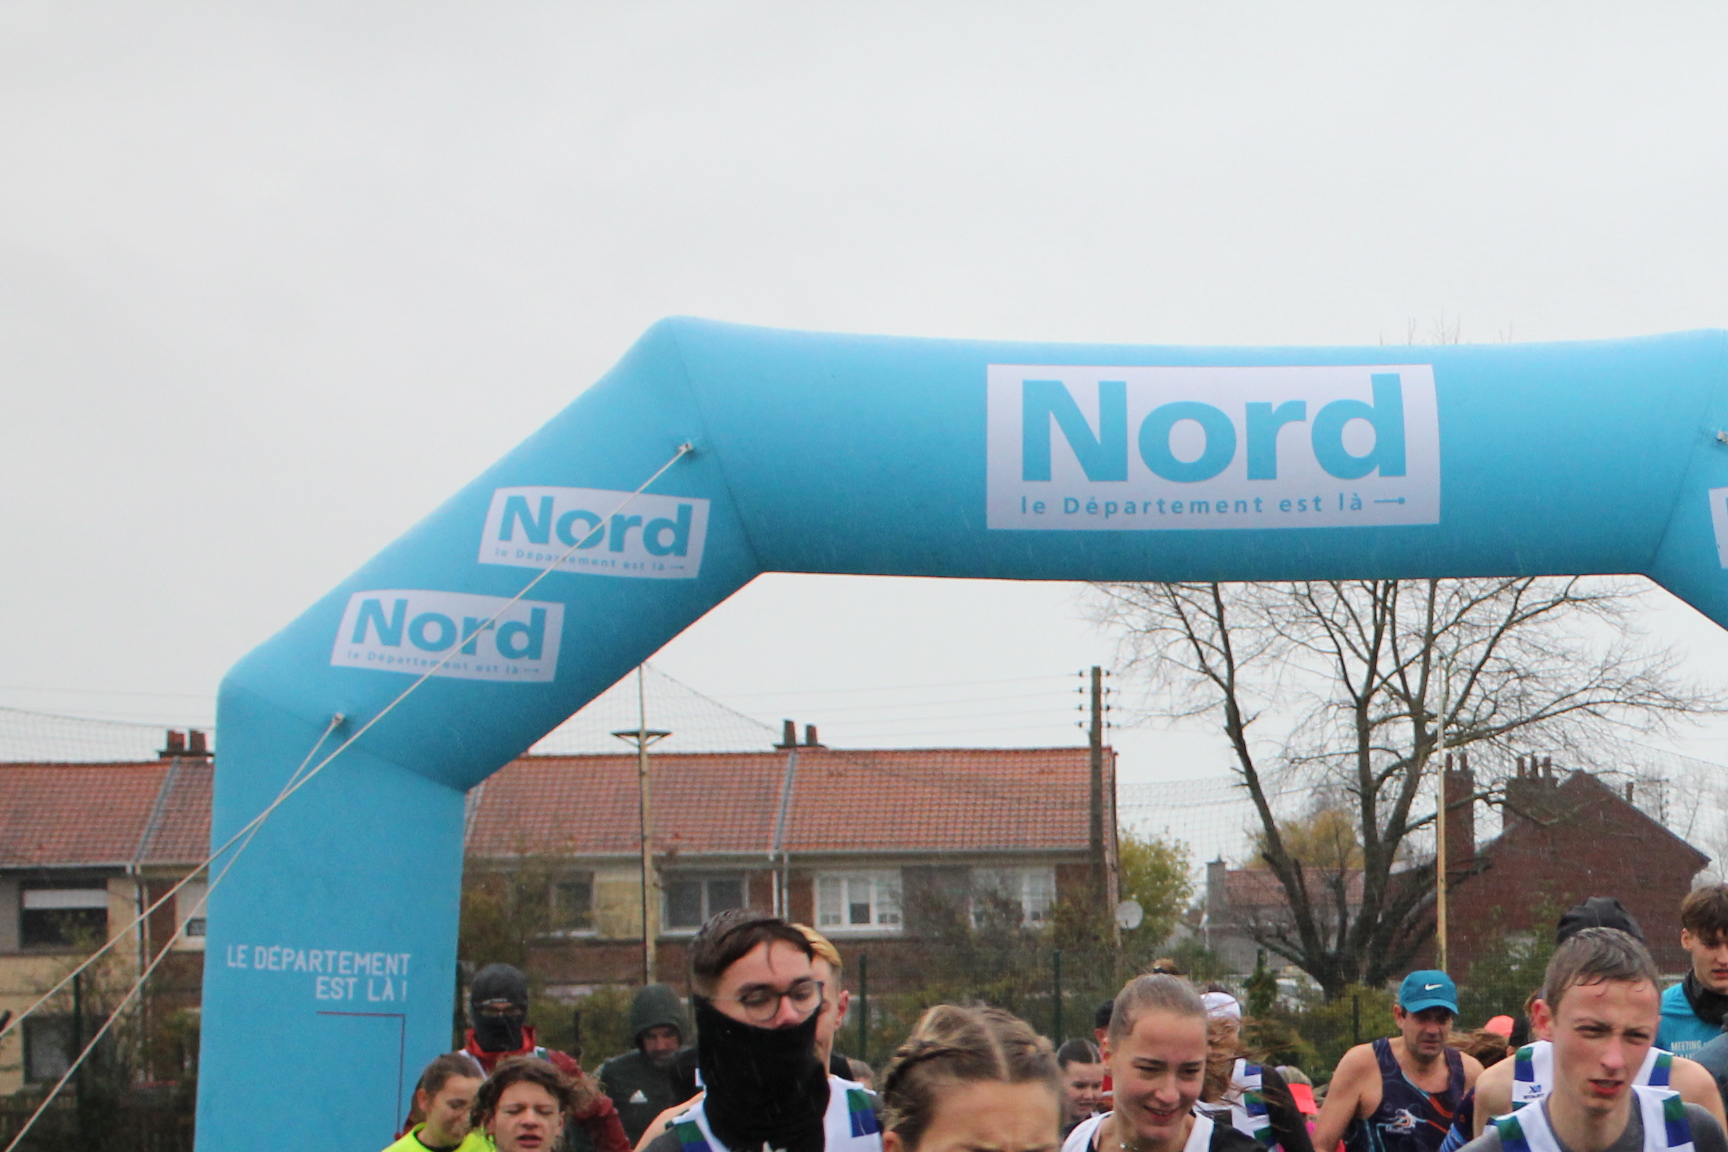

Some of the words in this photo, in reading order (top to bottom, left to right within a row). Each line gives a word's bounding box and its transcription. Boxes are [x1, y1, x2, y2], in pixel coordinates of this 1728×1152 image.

[1022, 373, 1406, 483] Nord
[1021, 496, 1046, 515] le
[1063, 494, 1264, 519] Département
[1279, 493, 1323, 513] est
[1339, 491, 1364, 511] là
[498, 495, 694, 557] Nord
[494, 547, 509, 557] le
[515, 548, 617, 570] Département
[622, 560, 646, 571] est
[651, 560, 666, 571] là
[351, 598, 547, 660] Nord
[346, 649, 361, 661] le
[367, 650, 469, 671] Département
[474, 661, 499, 673] est
[227, 945, 249, 969] LE
[253, 944, 412, 976] DÉPARTEMENT
[316, 976, 358, 1000] EST
[367, 977, 396, 1002] LÀ
